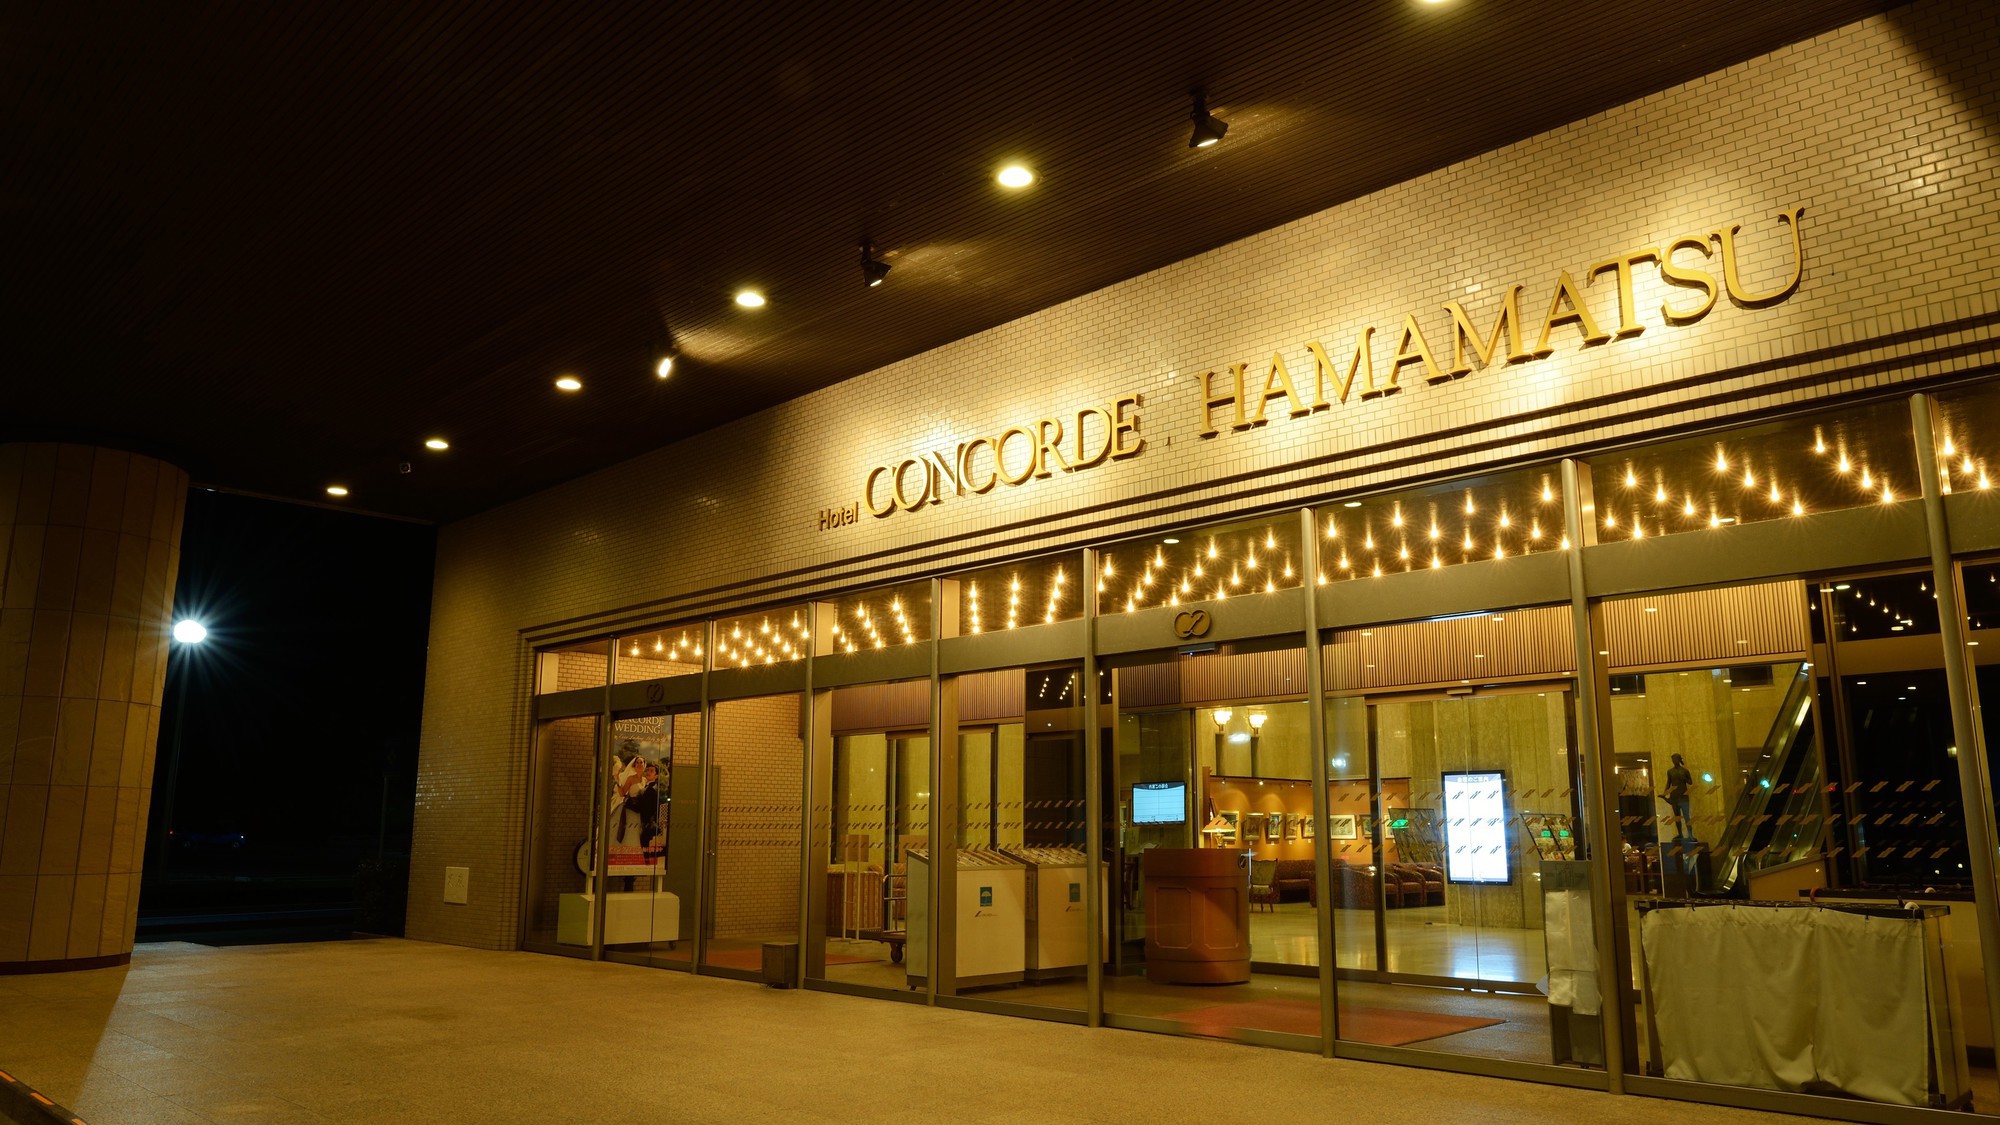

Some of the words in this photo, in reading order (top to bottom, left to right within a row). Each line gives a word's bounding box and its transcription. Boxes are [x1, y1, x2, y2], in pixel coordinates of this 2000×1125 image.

[819, 500, 859, 531] Hotel
[864, 393, 1146, 519] CONCORDE
[1194, 206, 1807, 439] HAMAMATSU
[614, 723, 661, 734] WEDDING
